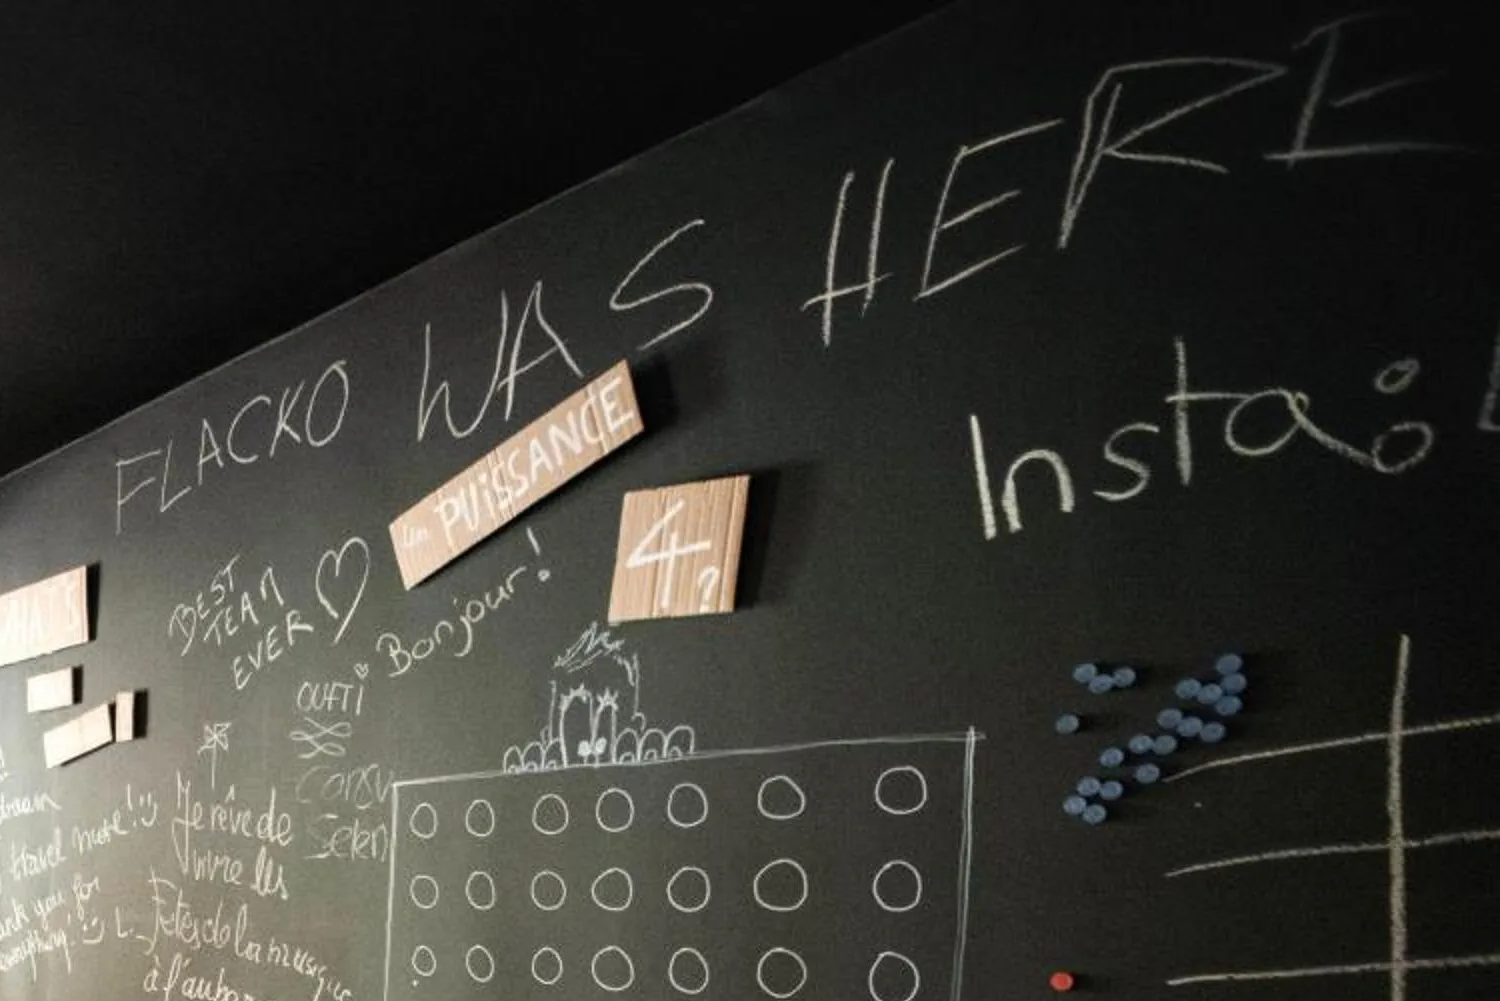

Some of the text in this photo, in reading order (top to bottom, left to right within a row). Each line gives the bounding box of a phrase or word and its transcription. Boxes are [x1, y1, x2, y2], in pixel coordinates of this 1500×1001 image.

[114, 10, 1468, 535] FLACKO WAS HERE
[168, 553, 241, 657] BEST
[201, 566, 285, 648] TEAM
[230, 608, 315, 691] EVER
